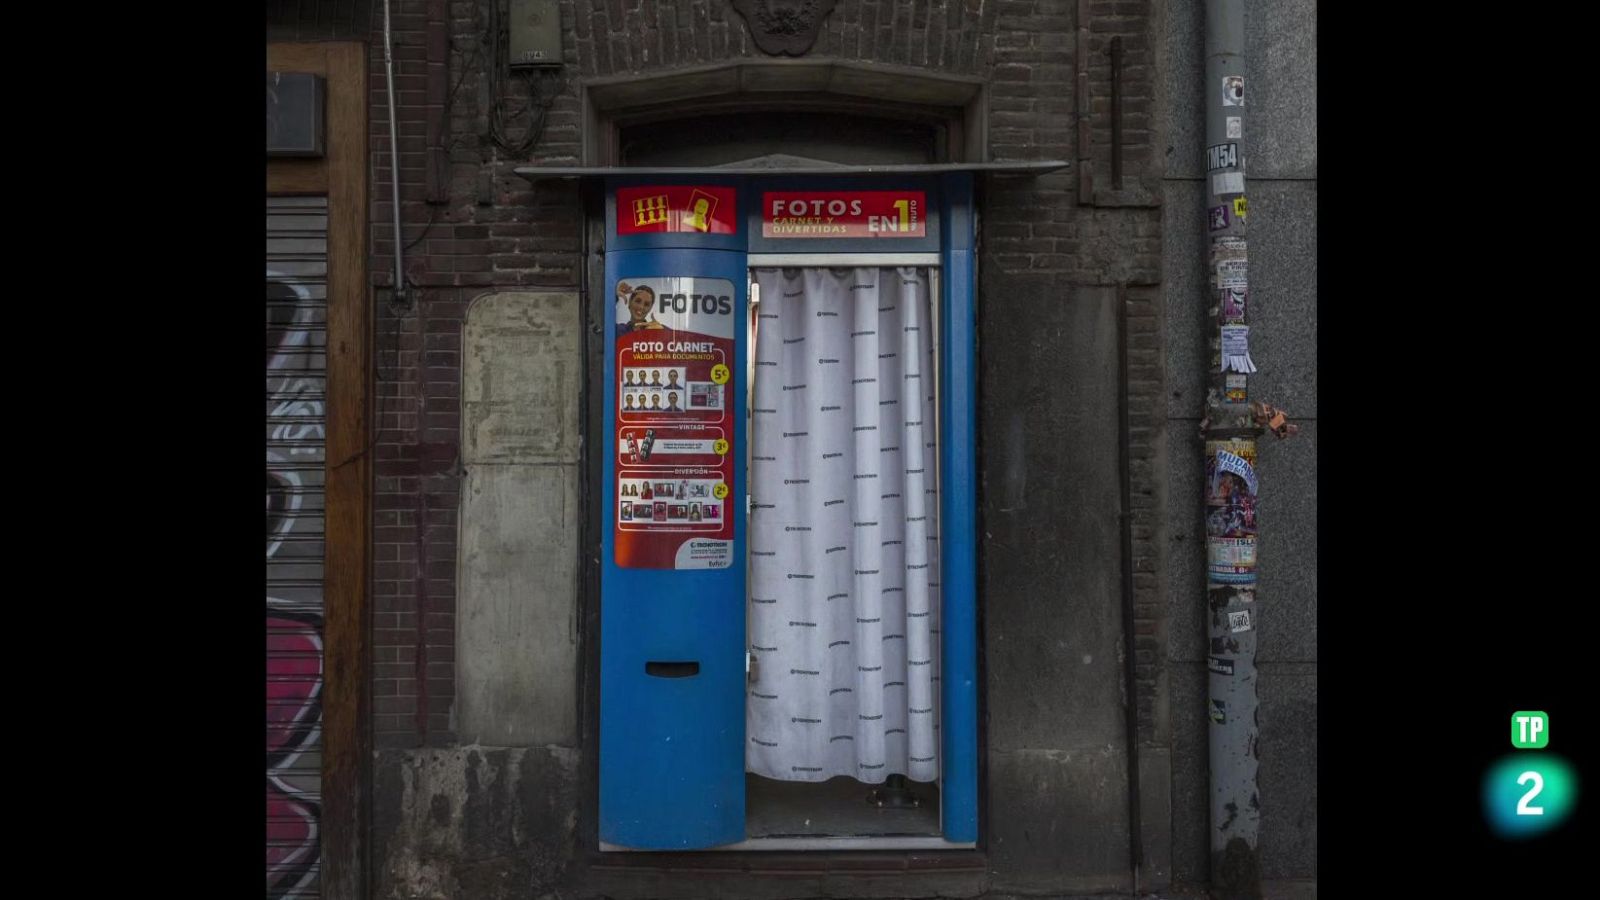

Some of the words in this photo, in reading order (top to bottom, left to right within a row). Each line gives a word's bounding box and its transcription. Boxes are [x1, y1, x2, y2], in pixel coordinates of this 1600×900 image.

[772, 199, 862, 216] FOTOS
[772, 217, 821, 226] CARNET
[868, 215, 897, 233] EN
[893, 199, 909, 233] 1
[772, 225, 847, 234] DIVERTIDAS
[659, 293, 732, 315] FOTOS
[632, 342, 664, 353] FOTO
[667, 341, 715, 353] CARNET
[672, 353, 715, 361] DOCUMENTOS
